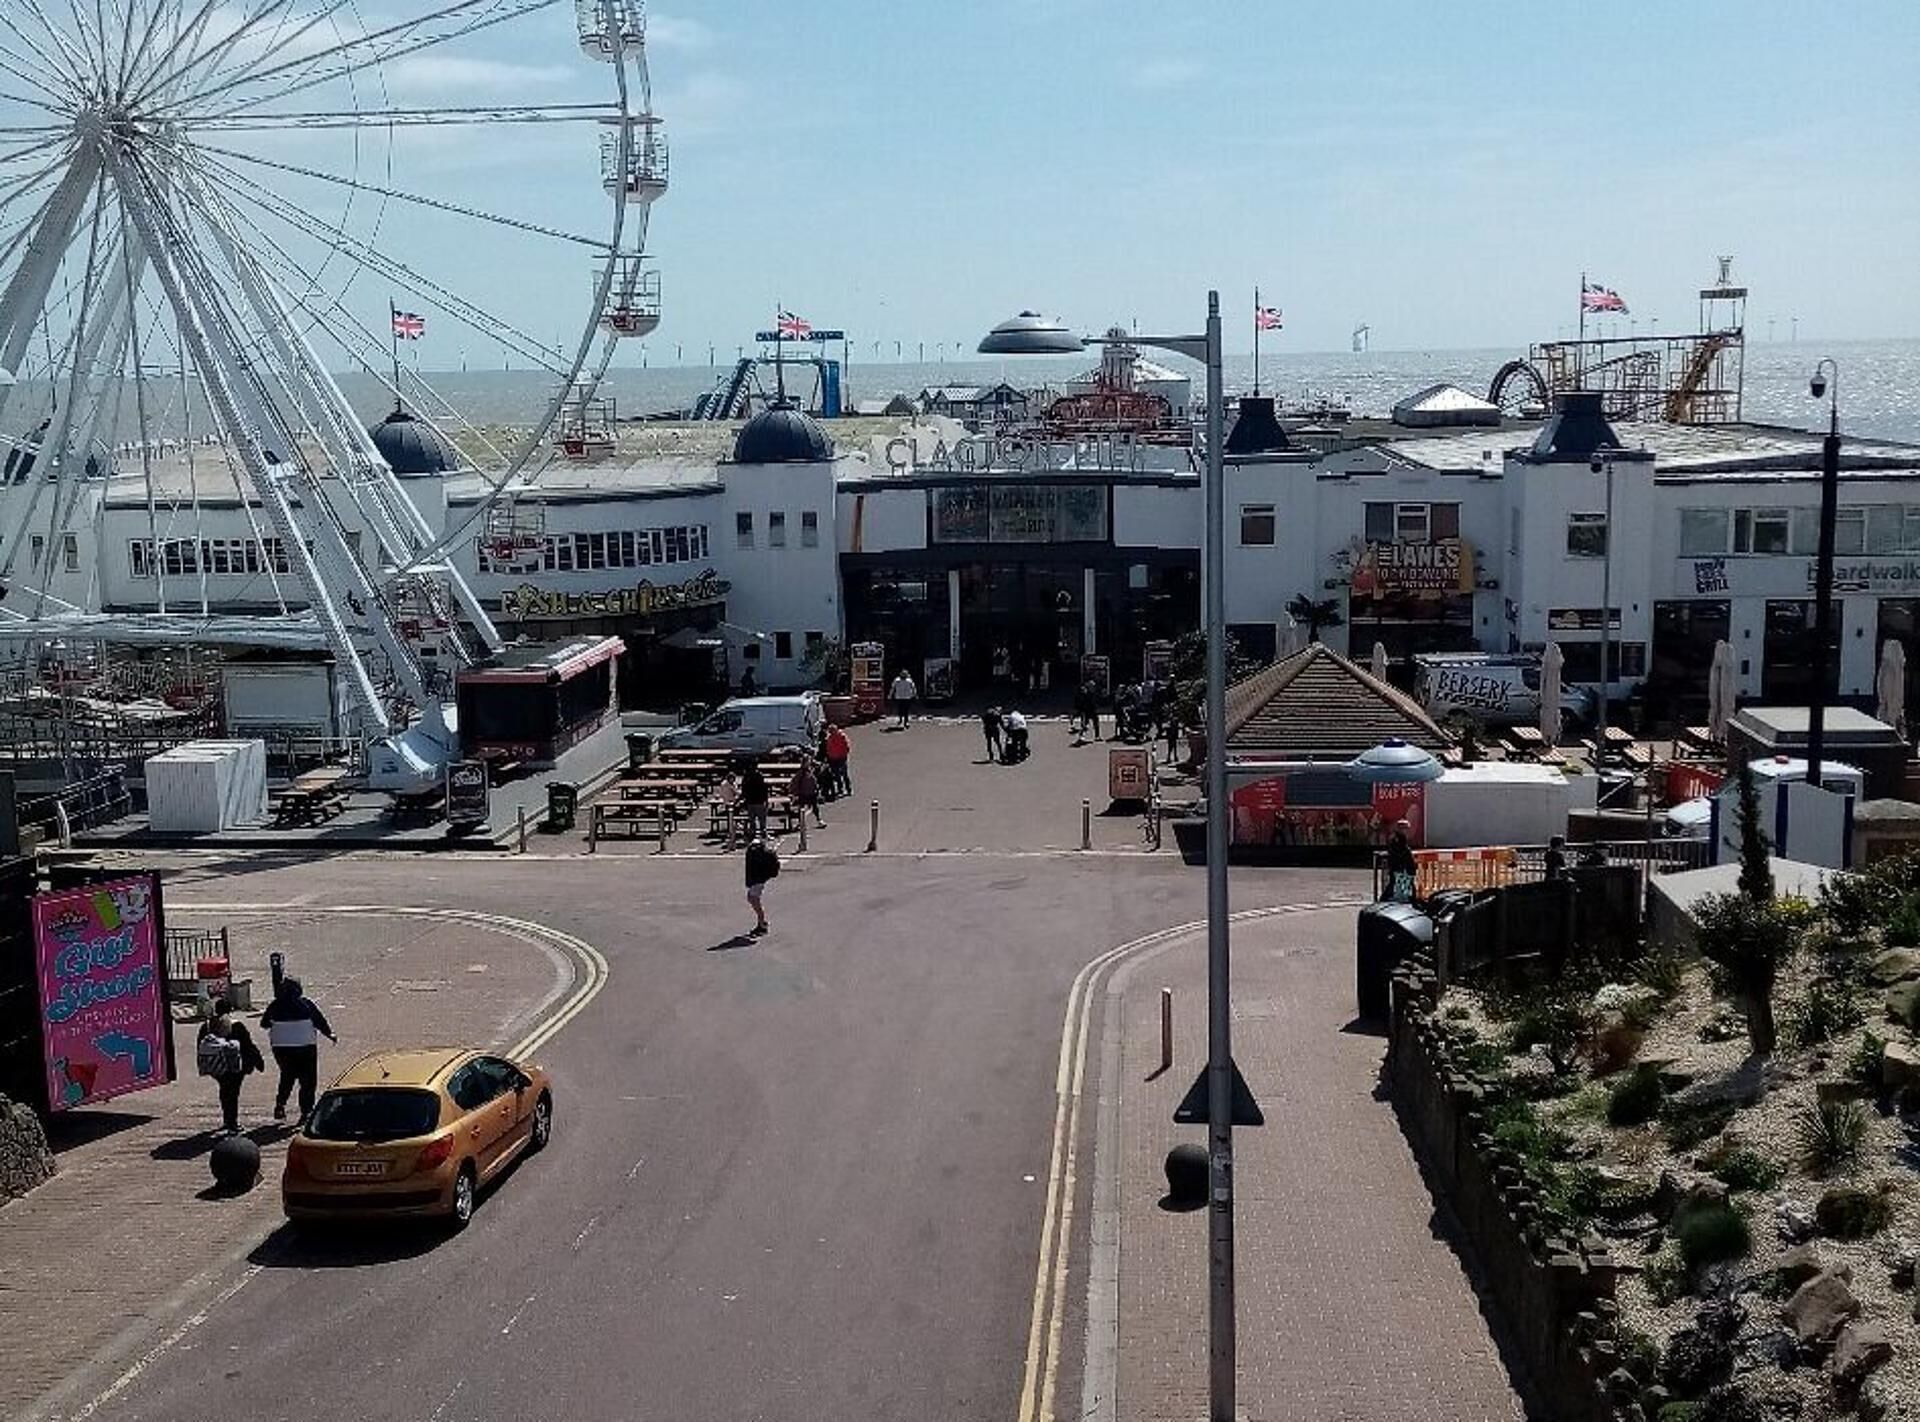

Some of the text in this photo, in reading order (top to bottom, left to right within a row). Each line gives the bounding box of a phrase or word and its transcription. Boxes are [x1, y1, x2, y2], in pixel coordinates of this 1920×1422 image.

[886, 437, 1049, 470] CLACTON
[1378, 544, 1392, 566] THE
[1392, 545, 1460, 568] LANES
[1807, 562, 1920, 580] bardwalk
[1438, 670, 1513, 701] BERSERK
[55, 926, 138, 978] Gift
[46, 965, 153, 1023] Shop
